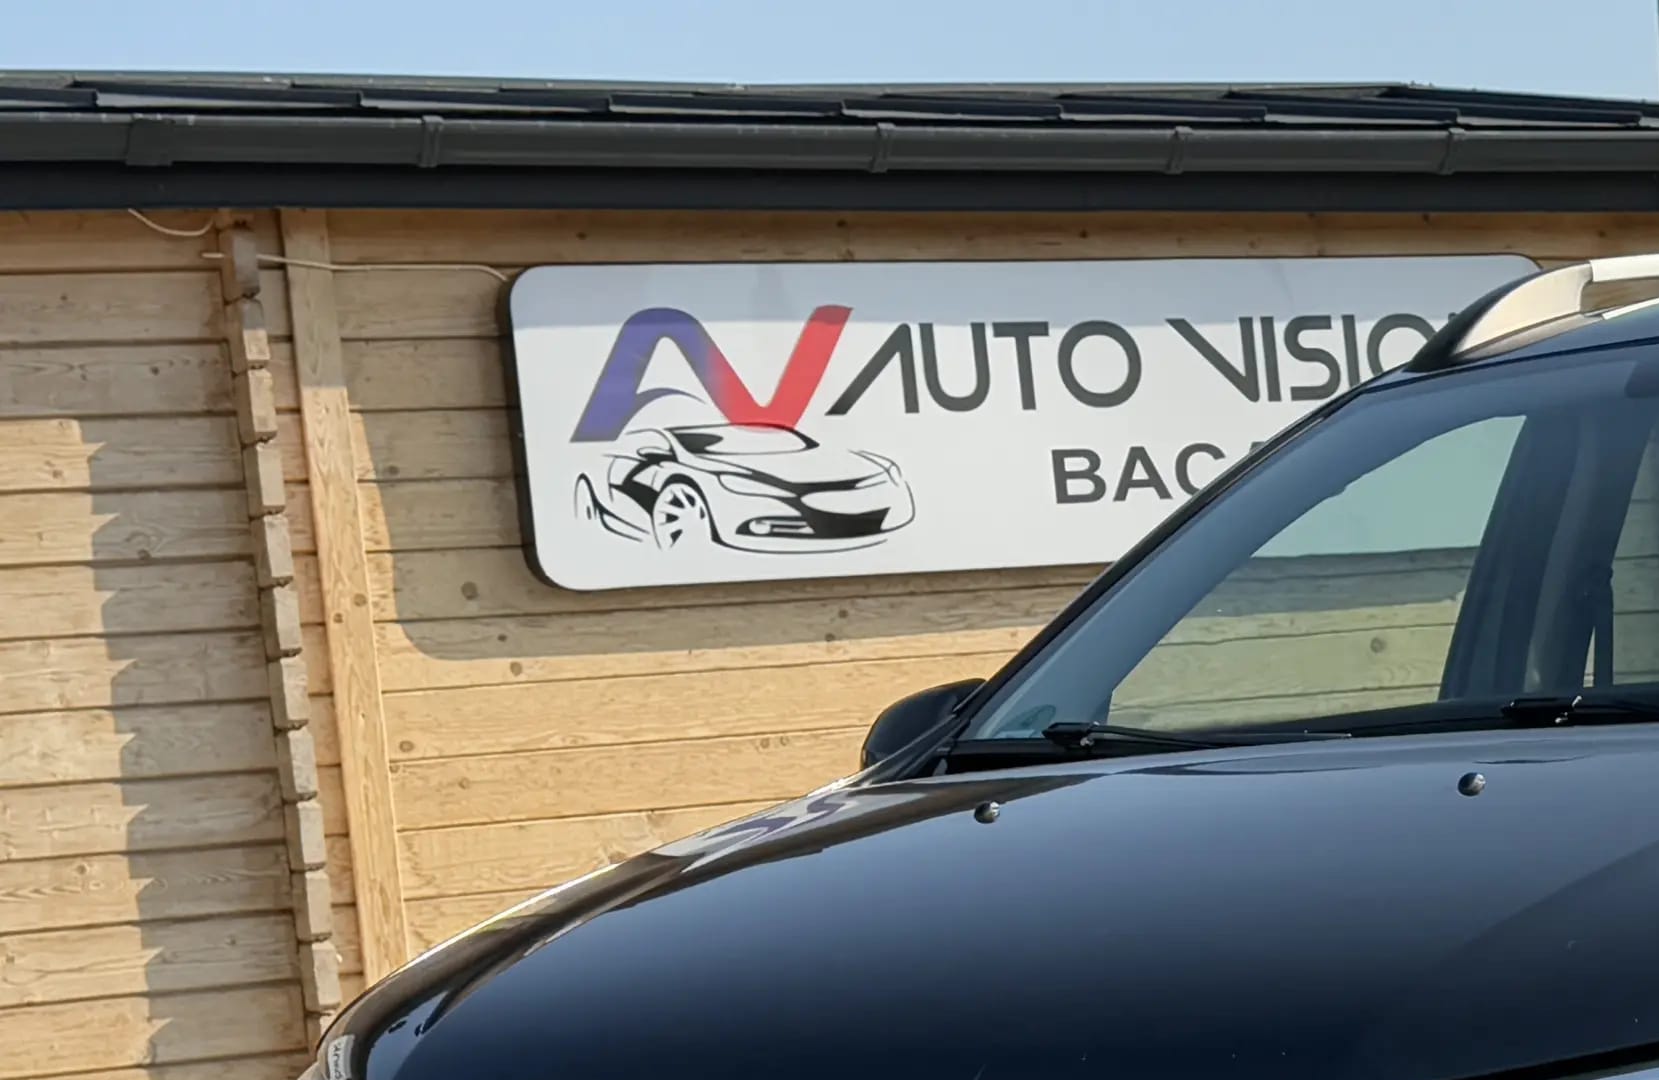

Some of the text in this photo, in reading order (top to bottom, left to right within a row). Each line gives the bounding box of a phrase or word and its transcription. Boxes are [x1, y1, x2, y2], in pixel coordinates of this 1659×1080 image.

[824, 313, 1456, 416] AUTO VISIO
[1051, 441, 1266, 504] BAC
